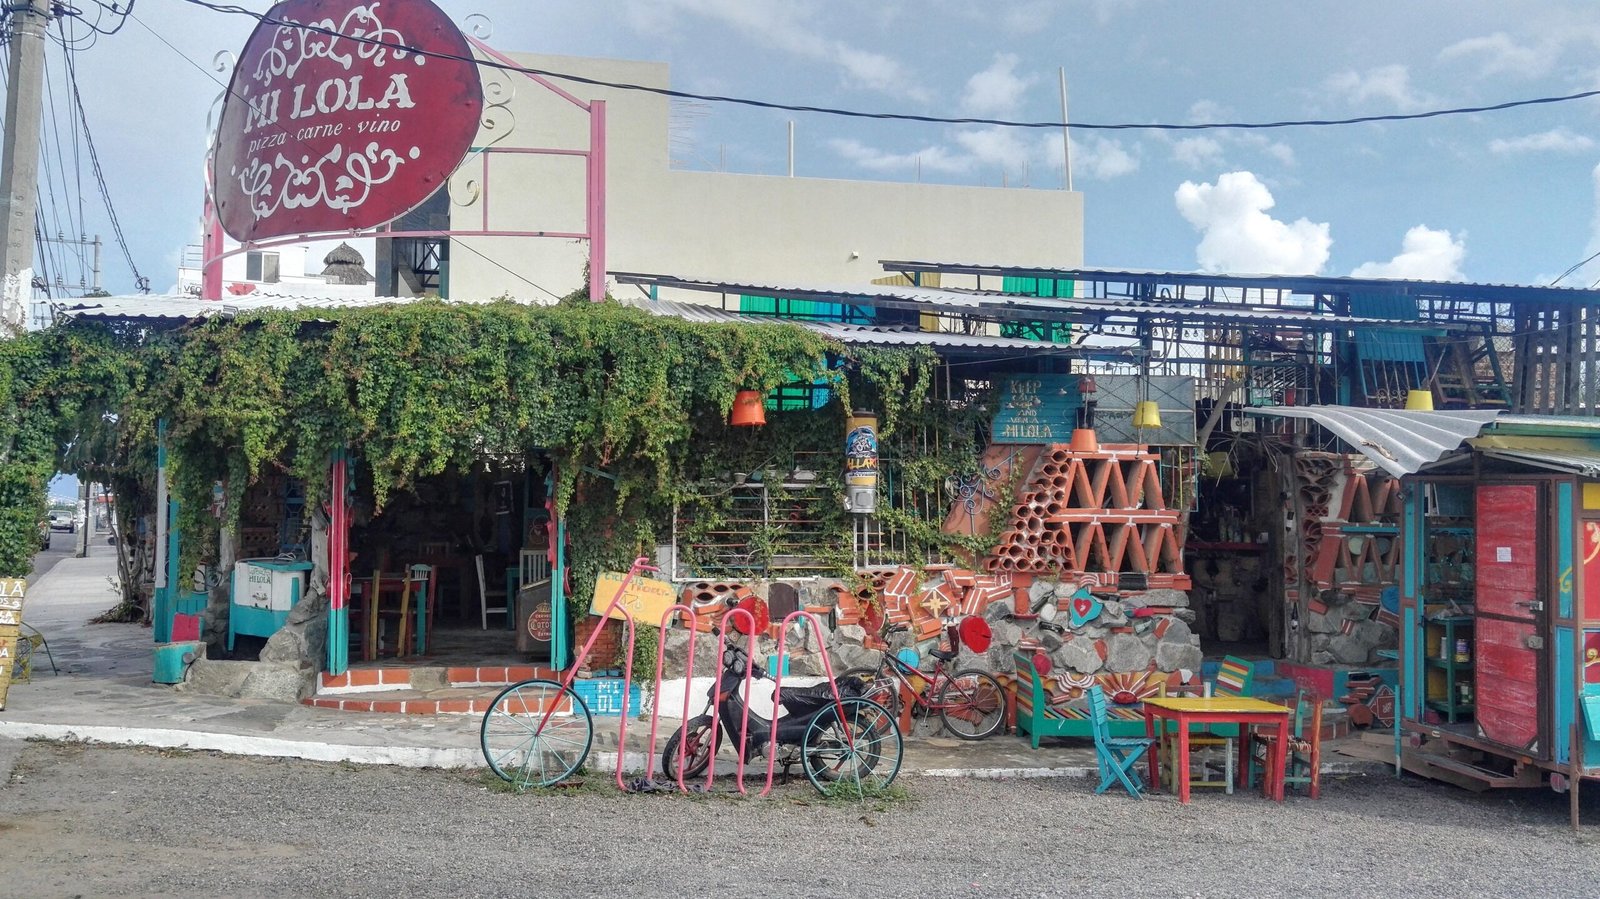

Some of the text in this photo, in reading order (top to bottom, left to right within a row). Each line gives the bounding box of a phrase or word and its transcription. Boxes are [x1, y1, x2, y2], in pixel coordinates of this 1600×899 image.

[244, 73, 416, 134] MI LOLA
[247, 113, 401, 159] pizza carne vino
[598, 681, 619, 694] MI
